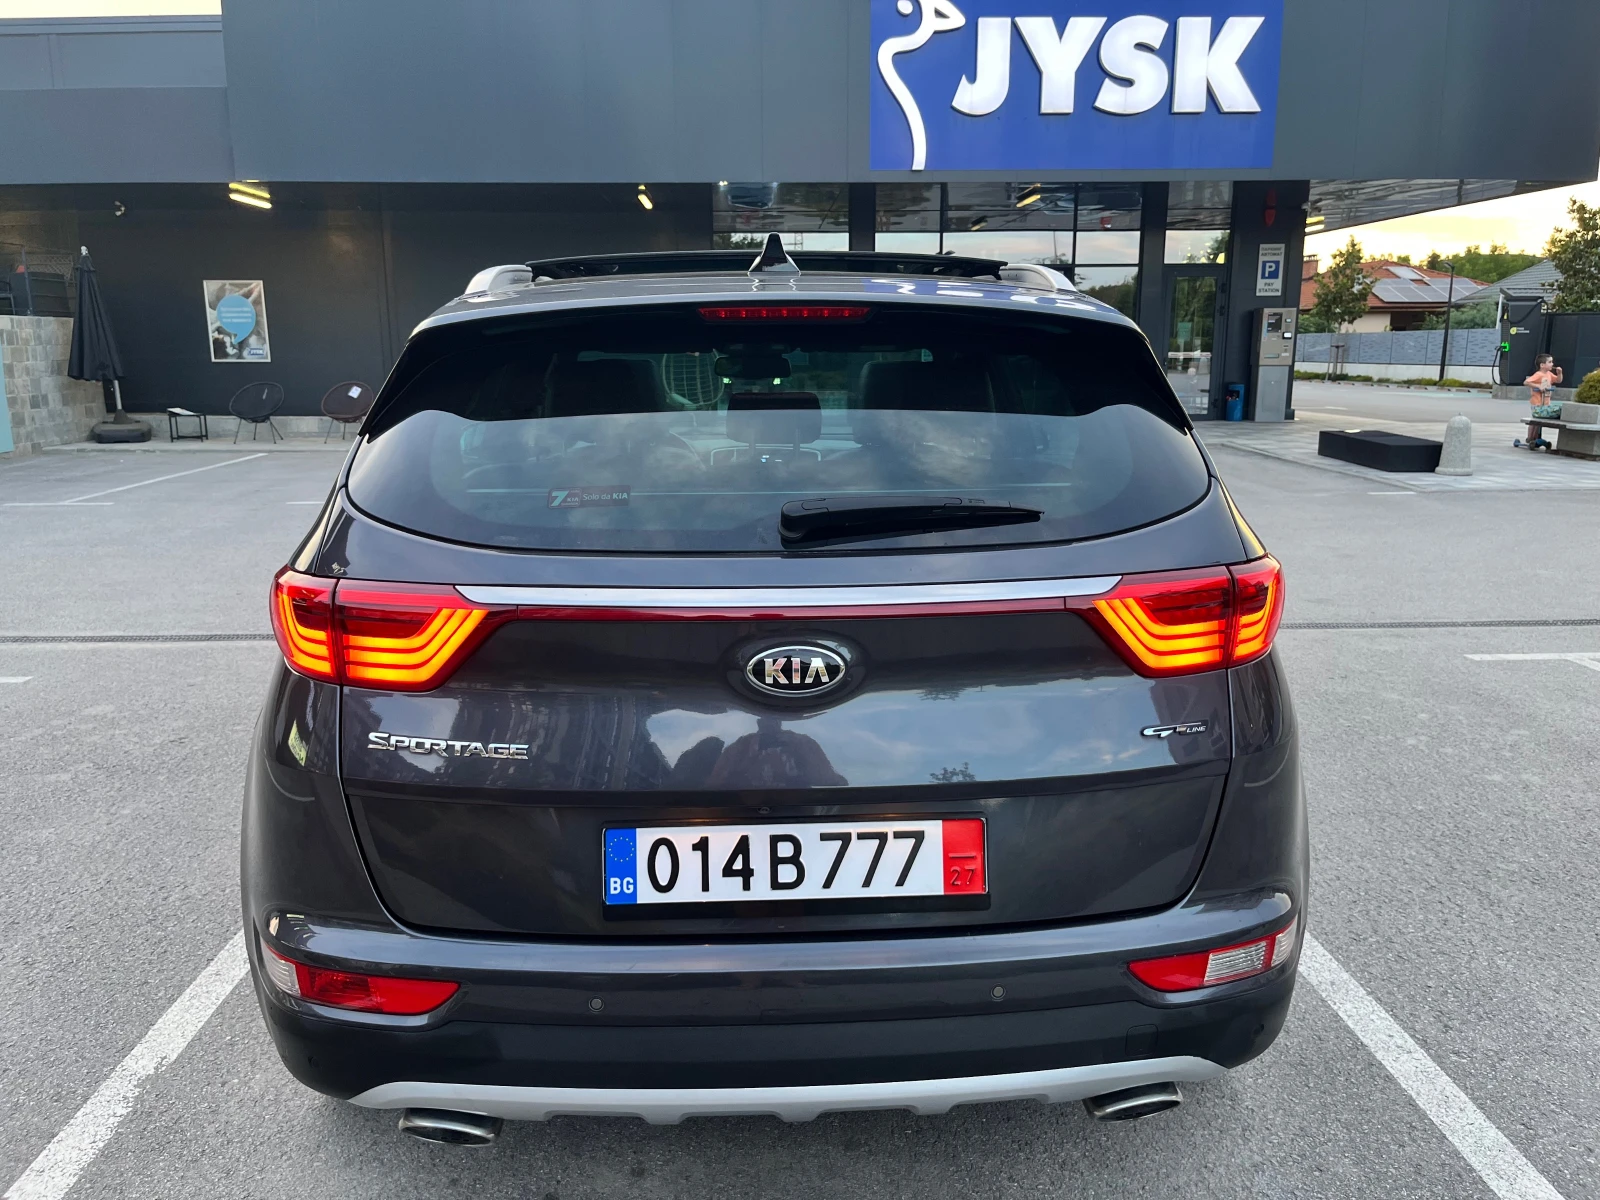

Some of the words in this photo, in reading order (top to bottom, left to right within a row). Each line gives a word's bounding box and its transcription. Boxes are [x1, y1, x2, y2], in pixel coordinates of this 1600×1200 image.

[951, 15, 1265, 116] JYSK
[1265, 262, 1276, 277] P
[601, 492, 610, 500] da
[613, 492, 628, 500] KIA
[763, 657, 830, 684] KIA
[367, 731, 529, 760] SPORTAGE
[609, 876, 635, 894] BG
[950, 867, 975, 886] 27
